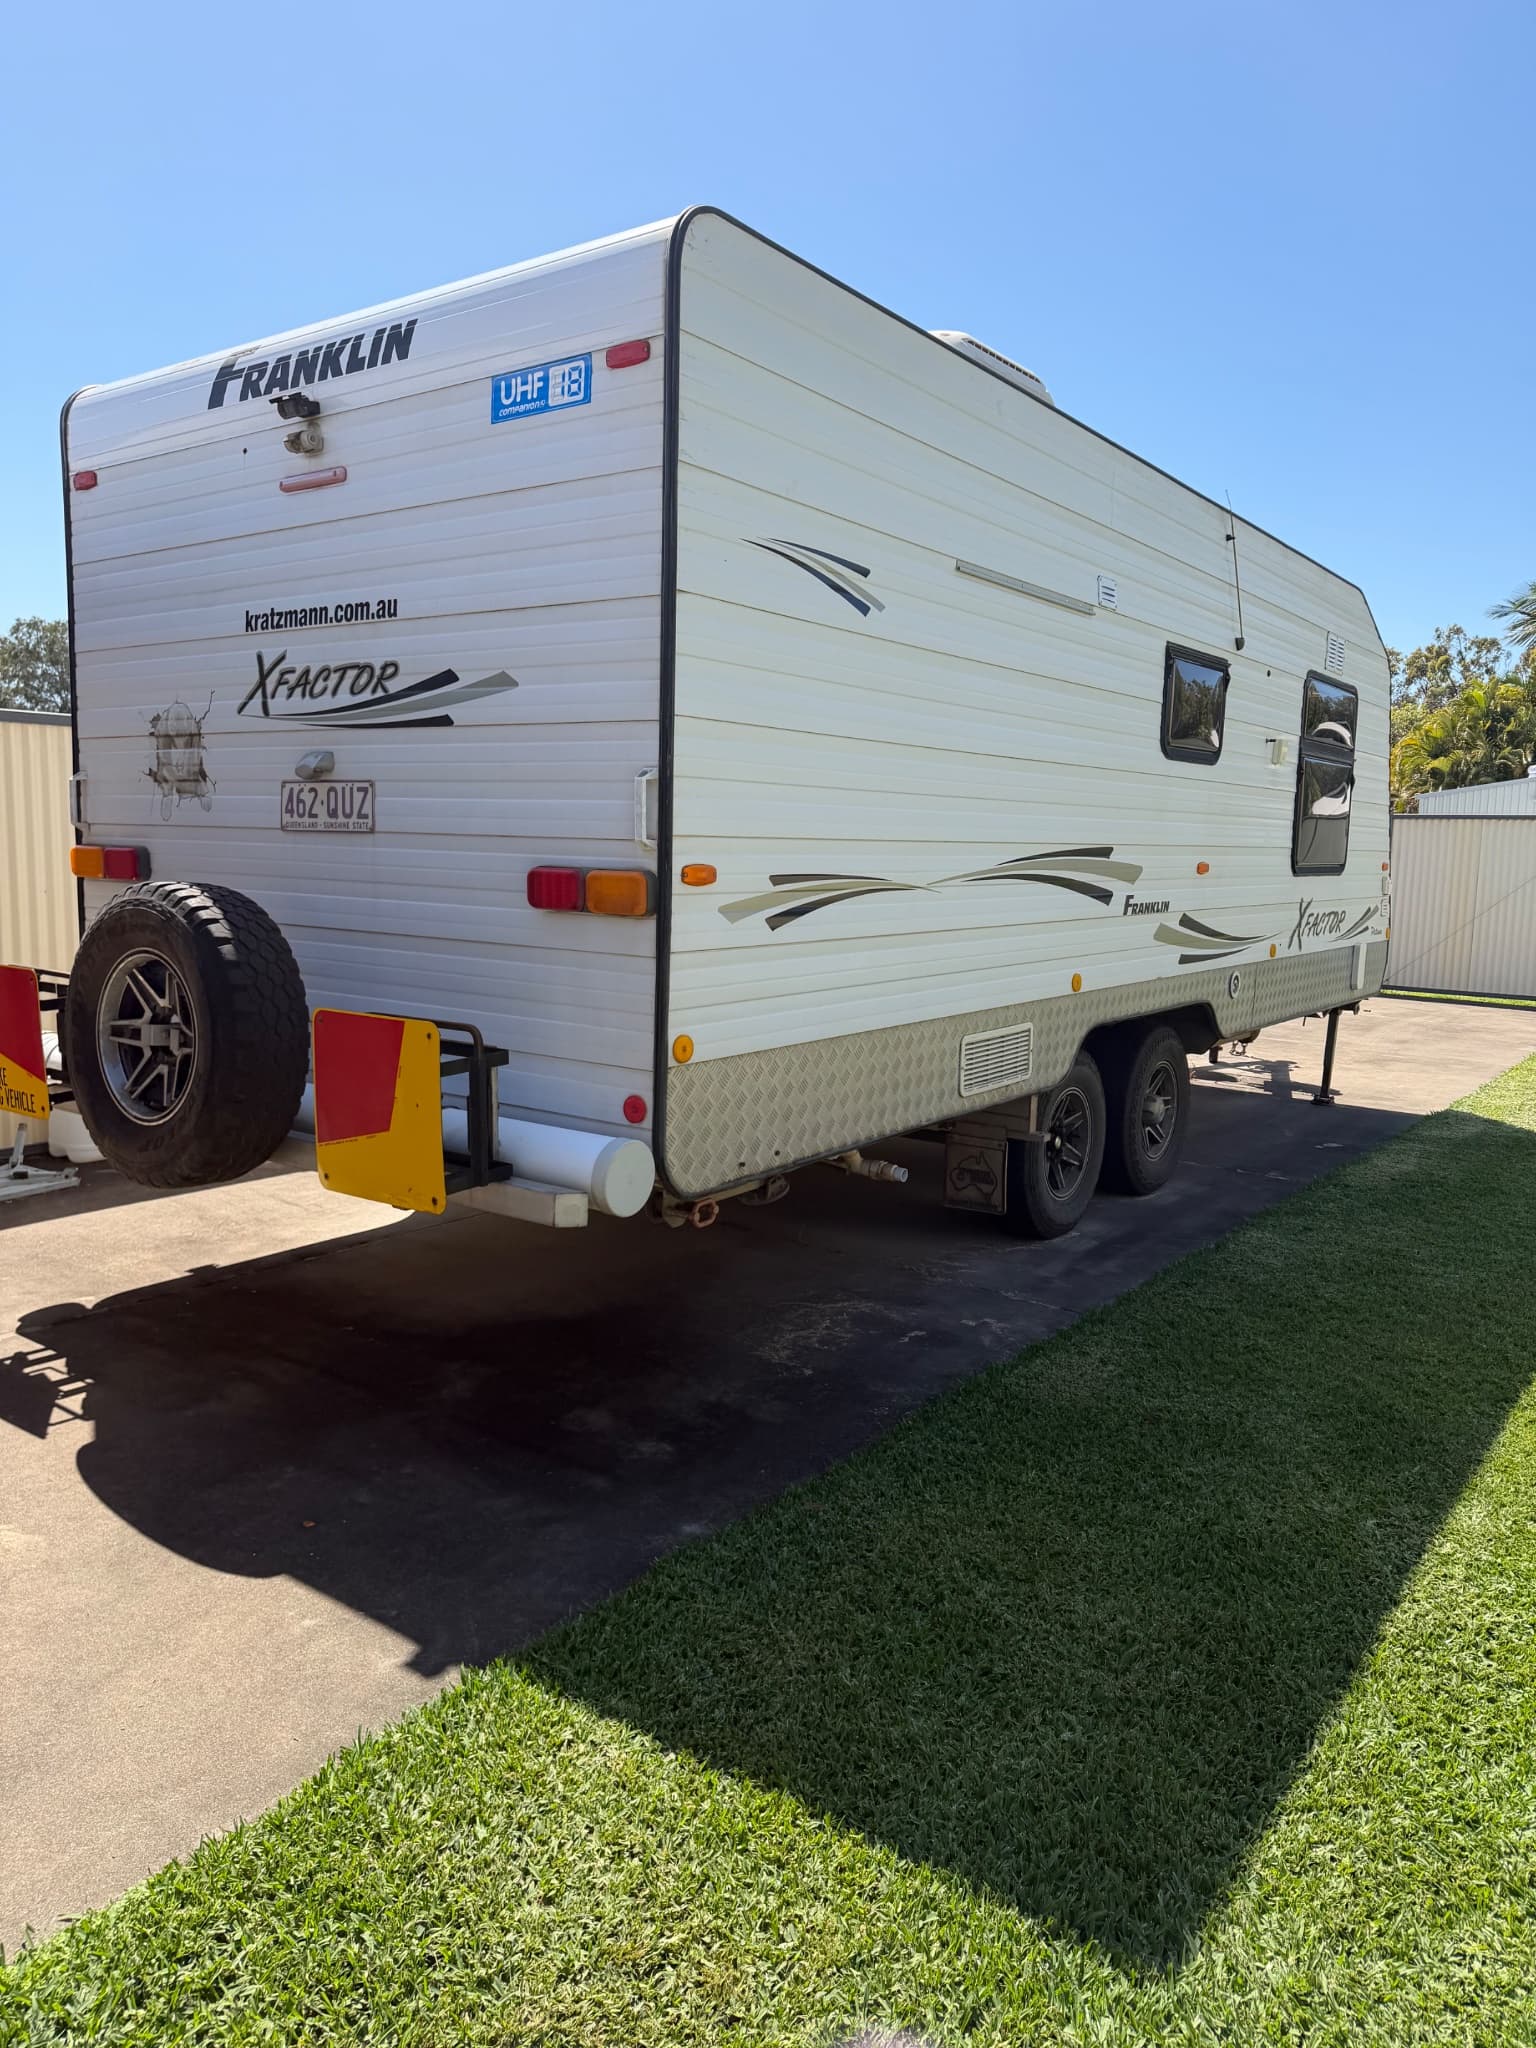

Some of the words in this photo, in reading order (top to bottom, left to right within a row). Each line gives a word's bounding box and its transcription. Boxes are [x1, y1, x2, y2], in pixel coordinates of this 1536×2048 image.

[208, 319, 418, 410] FRANKLIN
[500, 371, 544, 405] UHF
[561, 365, 584, 398] 18
[245, 599, 398, 632] kratzmann.com.au
[237, 649, 400, 717] XFACTOR
[353, 822, 369, 830] STATE
[1123, 894, 1170, 916] FRANKLIN
[1287, 897, 1346, 952] XFACTOR
[5, 1088, 37, 1113] VEHICLE
